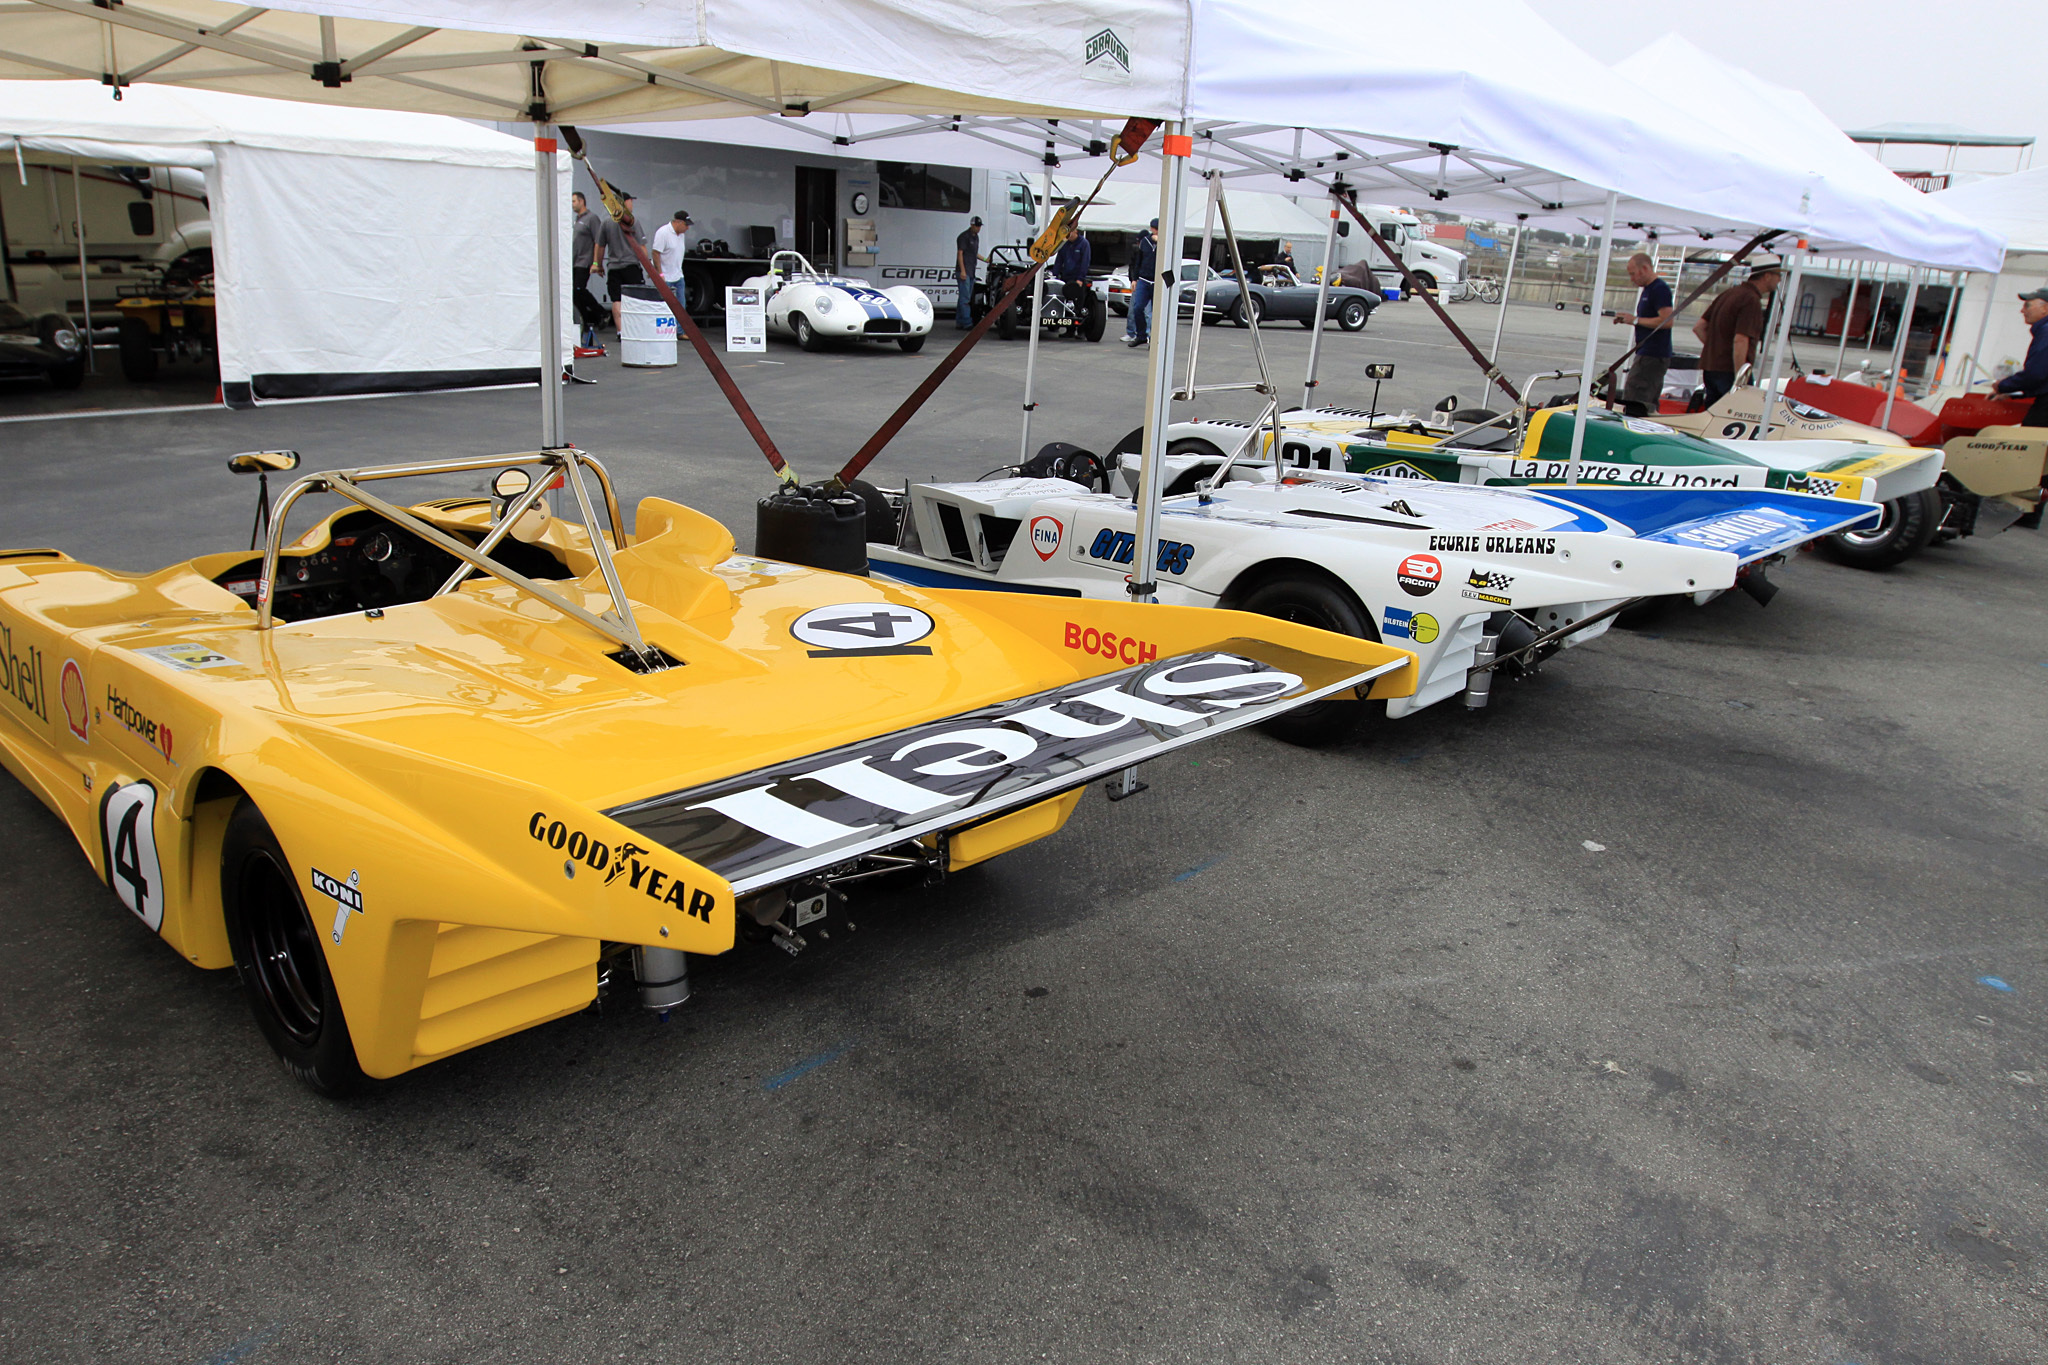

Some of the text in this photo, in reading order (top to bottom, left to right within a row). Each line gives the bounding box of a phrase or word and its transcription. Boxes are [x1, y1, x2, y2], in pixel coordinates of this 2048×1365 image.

[1086, 32, 1130, 69] CARAVAN
[857, 294, 889, 305] 60
[1734, 411, 1763, 421] PATRES
[1779, 409, 1798, 426] EINE
[1509, 459, 1539, 478] La
[1629, 464, 1664, 485] du
[1034, 527, 1058, 545] FINA
[1429, 535, 1556, 554] ECURIE ORLEANS
[1398, 576, 1437, 589] FACOM
[1478, 593, 1511, 605] MARCHAL
[1383, 616, 1410, 629] BILSTEIN
[1064, 621, 1158, 665] BOSCH
[107, 683, 158, 745] Hartpower
[114, 800, 150, 917] 4
[312, 871, 363, 911] KONI
